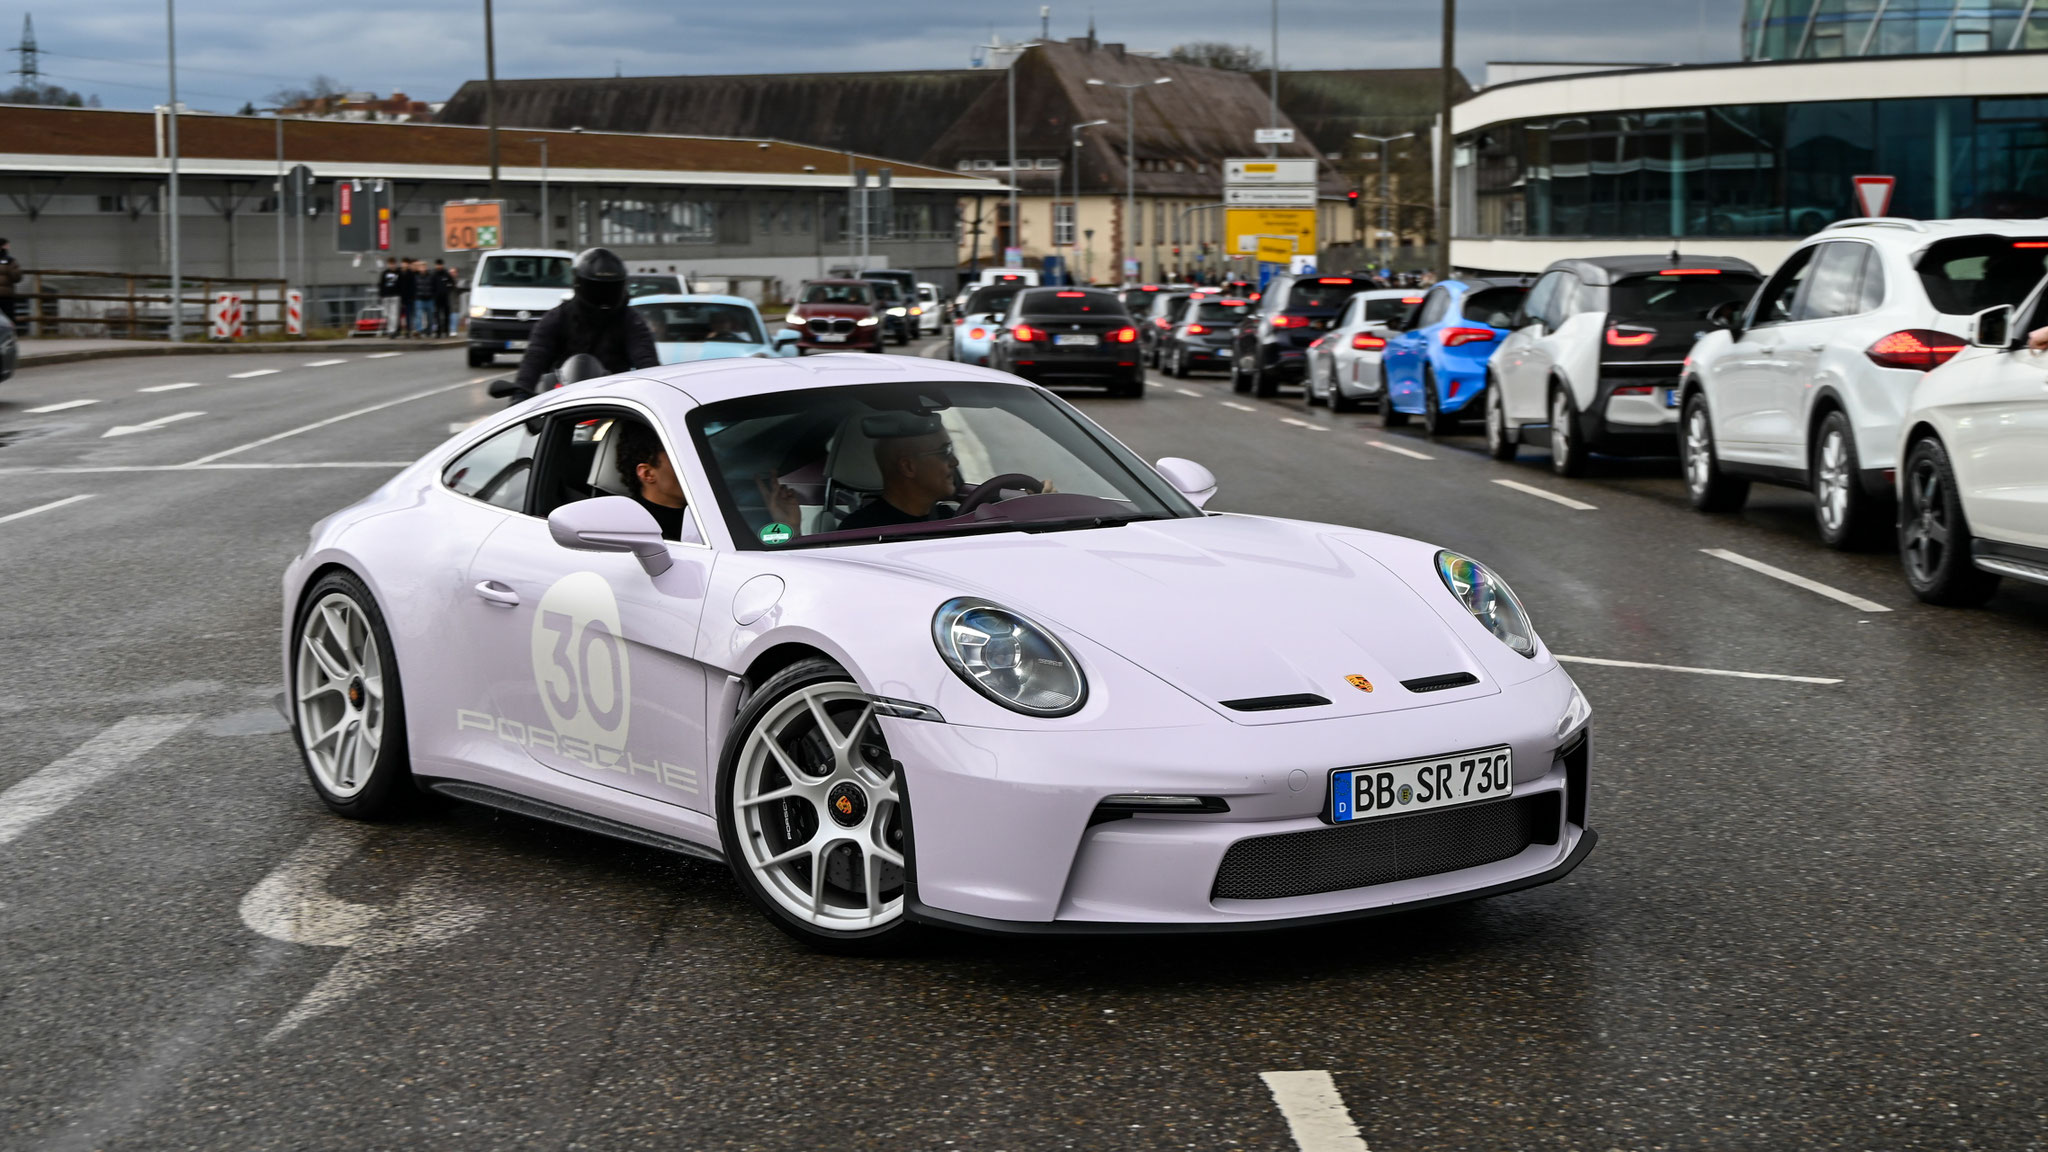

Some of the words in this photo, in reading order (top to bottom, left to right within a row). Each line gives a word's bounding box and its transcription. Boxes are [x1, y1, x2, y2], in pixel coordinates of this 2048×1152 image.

[771, 524, 781, 533] 4
[543, 610, 623, 732] 30
[457, 709, 699, 795] PORSCHE
[1339, 802, 1347, 812] D
[1355, 772, 1395, 812] BB
[1417, 764, 1452, 802] SR
[1460, 755, 1508, 796] 730
